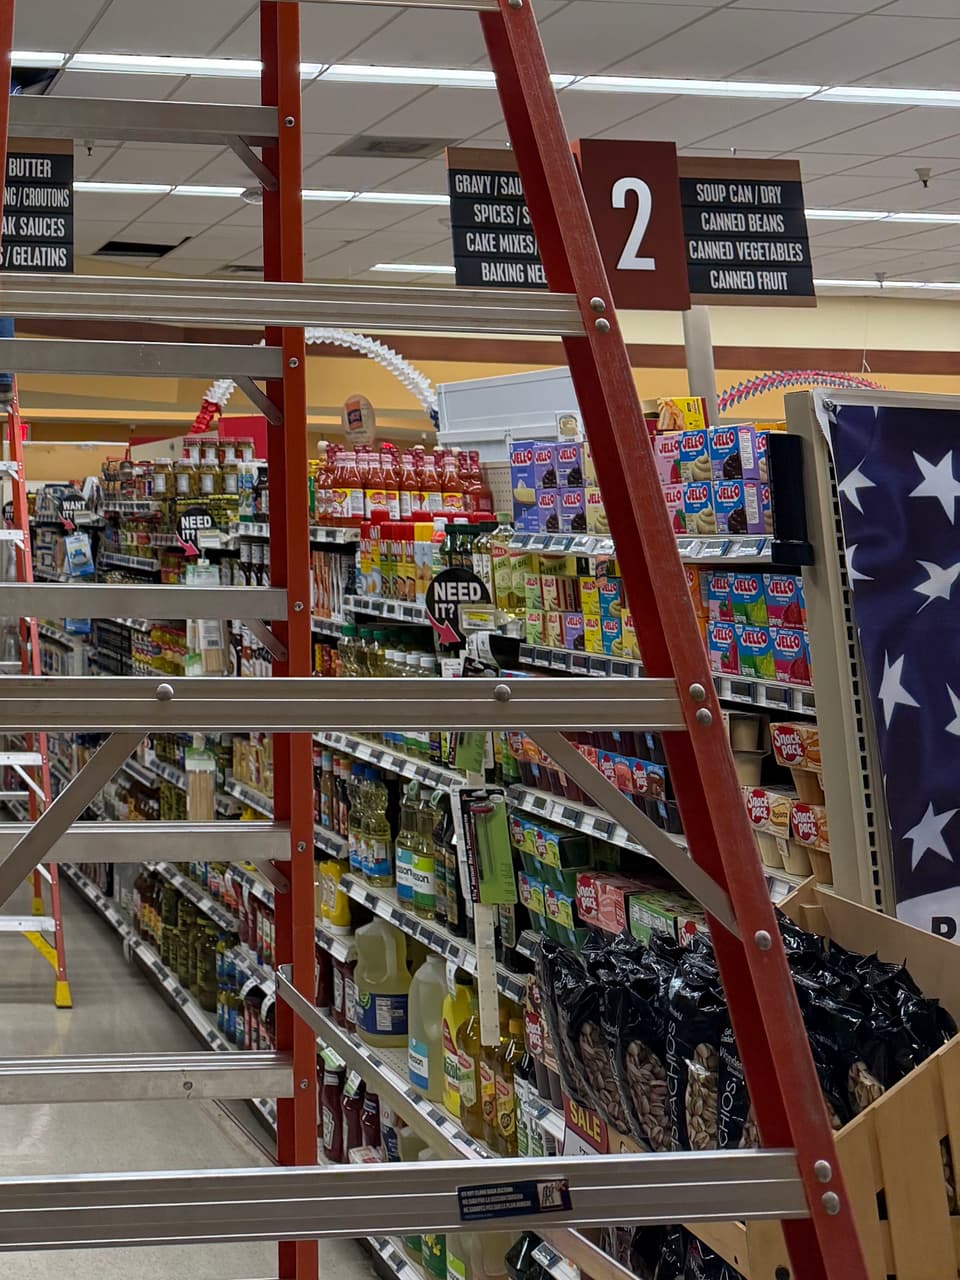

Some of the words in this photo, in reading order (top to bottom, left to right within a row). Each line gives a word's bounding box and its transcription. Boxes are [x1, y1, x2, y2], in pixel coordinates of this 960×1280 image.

[8, 157, 52, 178] BUTTER
[455, 174, 492, 194] GRAVY
[500, 176, 523, 195] SAU
[696, 183, 726, 203] SOUP
[473, 203, 514, 224] SPICES
[611, 176, 656, 270] 2
[701, 212, 746, 232] CANNED
[748, 214, 785, 233] BEANS
[19, 217, 65, 238] SAUCES
[466, 232, 497, 252] CAKE
[689, 240, 734, 260] CANNED
[737, 241, 804, 261] VEGETABLES
[12, 247, 67, 267] GELATINS
[481, 262, 525, 283] BAKING
[710, 270, 755, 290] CANNED
[757, 272, 788, 291] FRUIT
[62, 500, 86, 510] WANT
[62, 511, 74, 519] IT?
[181, 515, 212, 529] NEED
[181, 529, 197, 541] IT?
[433, 581, 482, 601] NEED
[434, 603, 456, 619] IT?
[774, 730, 801, 747] Snack
[781, 744, 804, 758] pack
[748, 793, 769, 808] Snack
[751, 806, 769, 819] pack
[792, 807, 816, 823] Snack
[798, 823, 817, 835] pack
[666, 1019, 681, 1152] ISTACHIOS
[568, 1100, 602, 1144] SALE
